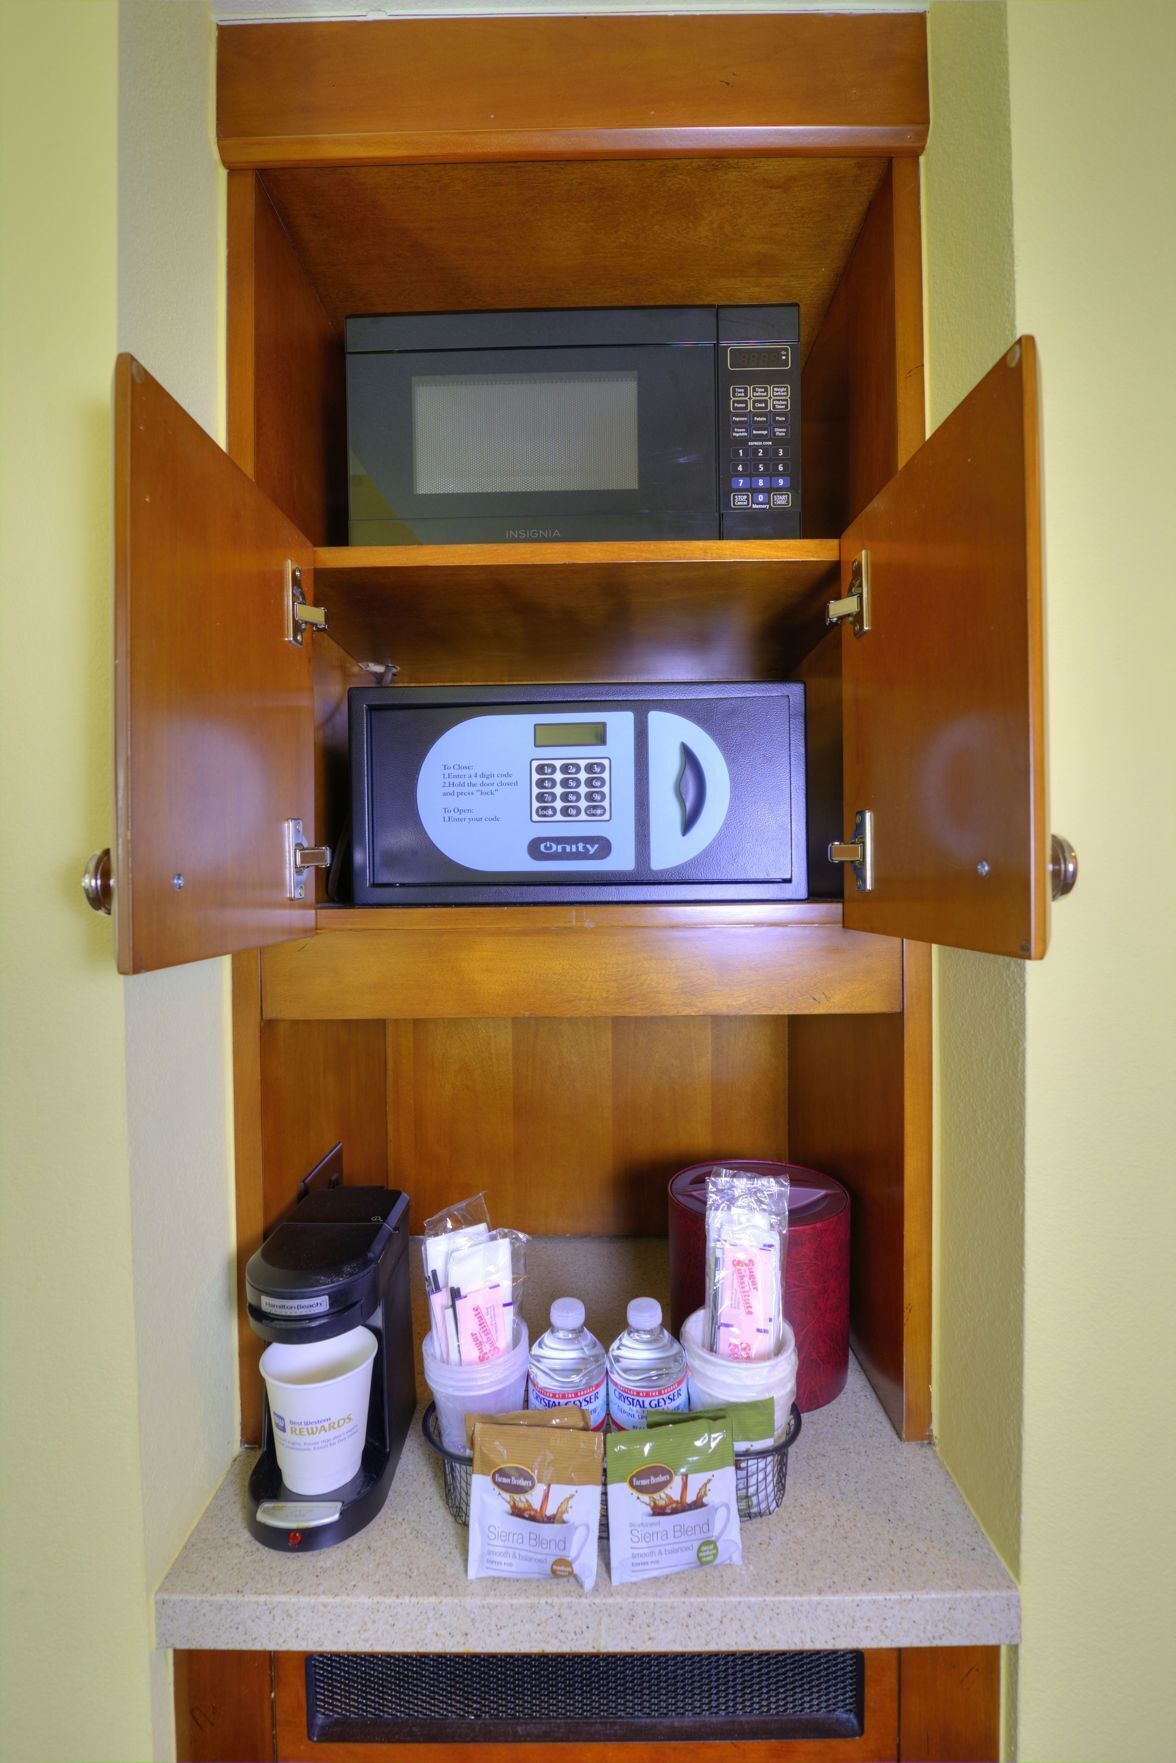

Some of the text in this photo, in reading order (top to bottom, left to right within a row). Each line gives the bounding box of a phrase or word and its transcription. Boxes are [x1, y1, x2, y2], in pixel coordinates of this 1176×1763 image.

[506, 529, 560, 538] INSIGNIA
[540, 842, 599, 854] Onity
[744, 1258, 758, 1292] Sugar
[732, 1259, 753, 1315] Substitute
[266, 1302, 296, 1310] Hamilton
[472, 1305, 500, 1356] Substitute
[470, 1332, 489, 1362] Sugar
[614, 1388, 682, 1408] CRYSTAL GEYSER
[290, 1413, 352, 1436] REWARDS
[304, 1417, 331, 1425] Western
[496, 1474, 532, 1486] Farmer Brothers
[633, 1474, 670, 1486] Farmer Brothers
[487, 1525, 566, 1551] Sierra Blend
[630, 1520, 710, 1544] Sierra Blend
[664, 1544, 693, 1556] balanced
